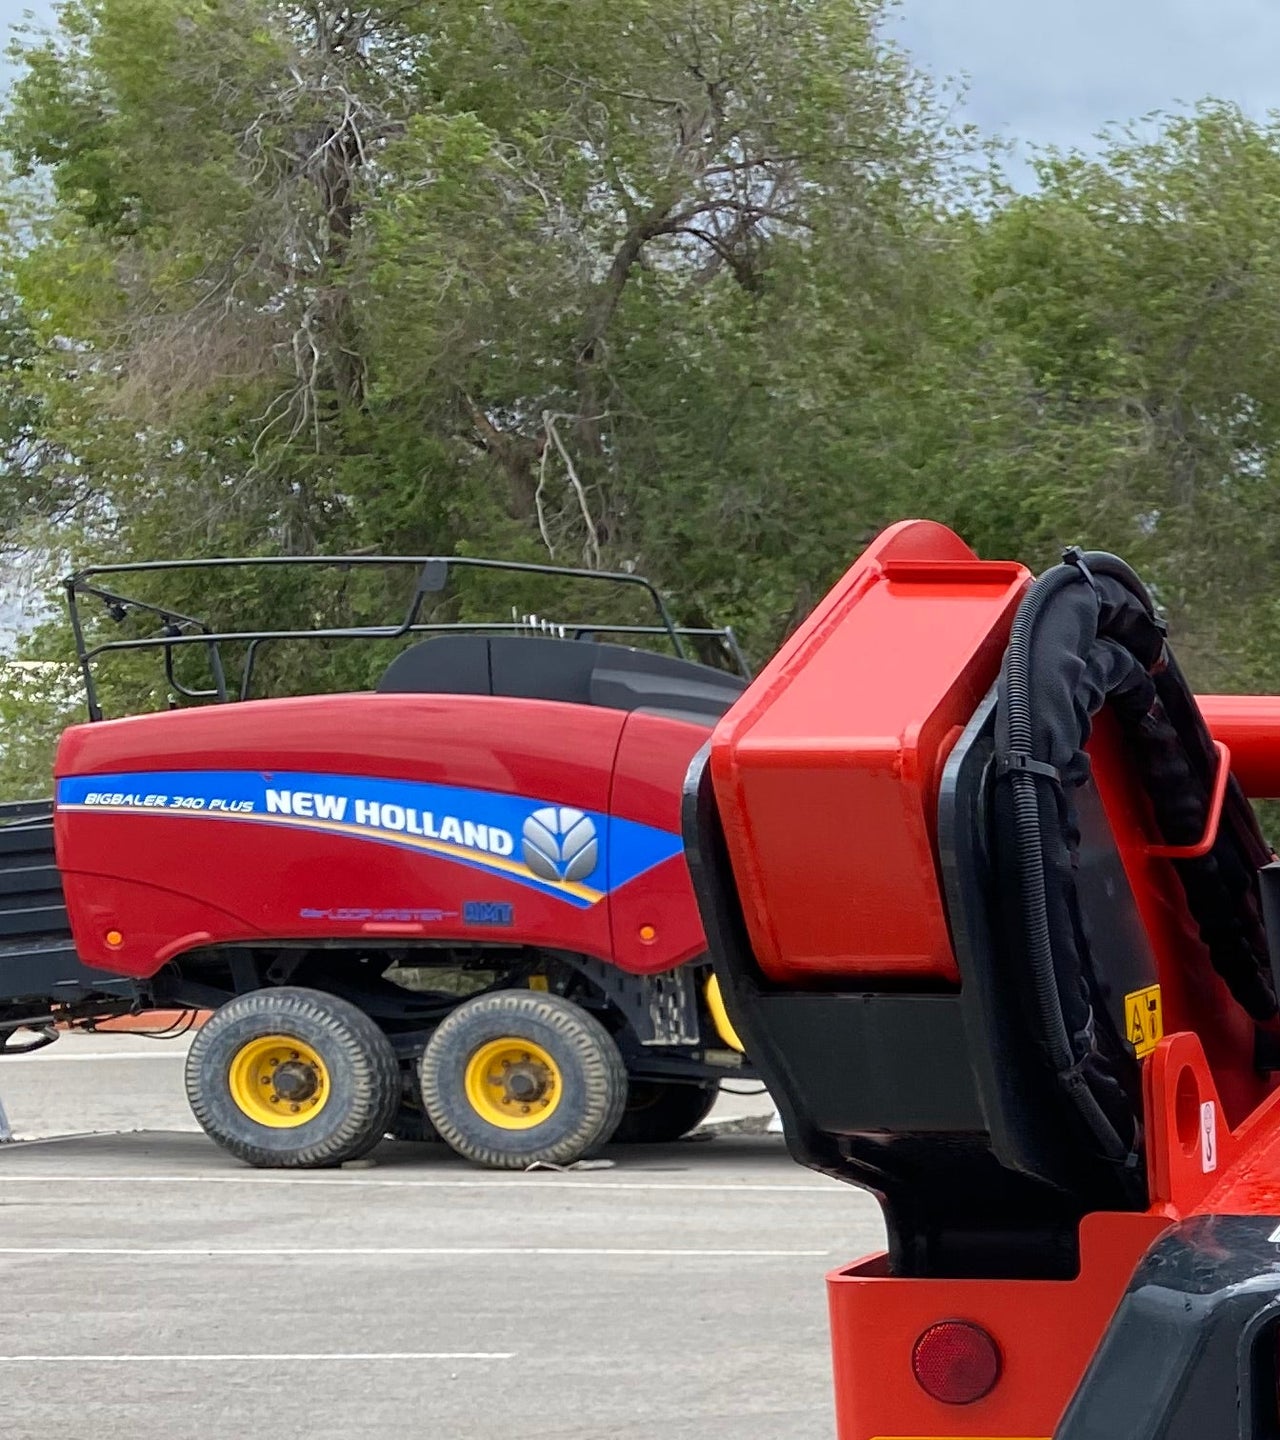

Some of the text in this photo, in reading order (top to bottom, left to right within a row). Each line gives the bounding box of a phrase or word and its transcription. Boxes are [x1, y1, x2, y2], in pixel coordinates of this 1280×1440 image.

[84, 792, 254, 812] BIGBALER 340 PLUS
[265, 788, 514, 856] NEW HOLLAND
